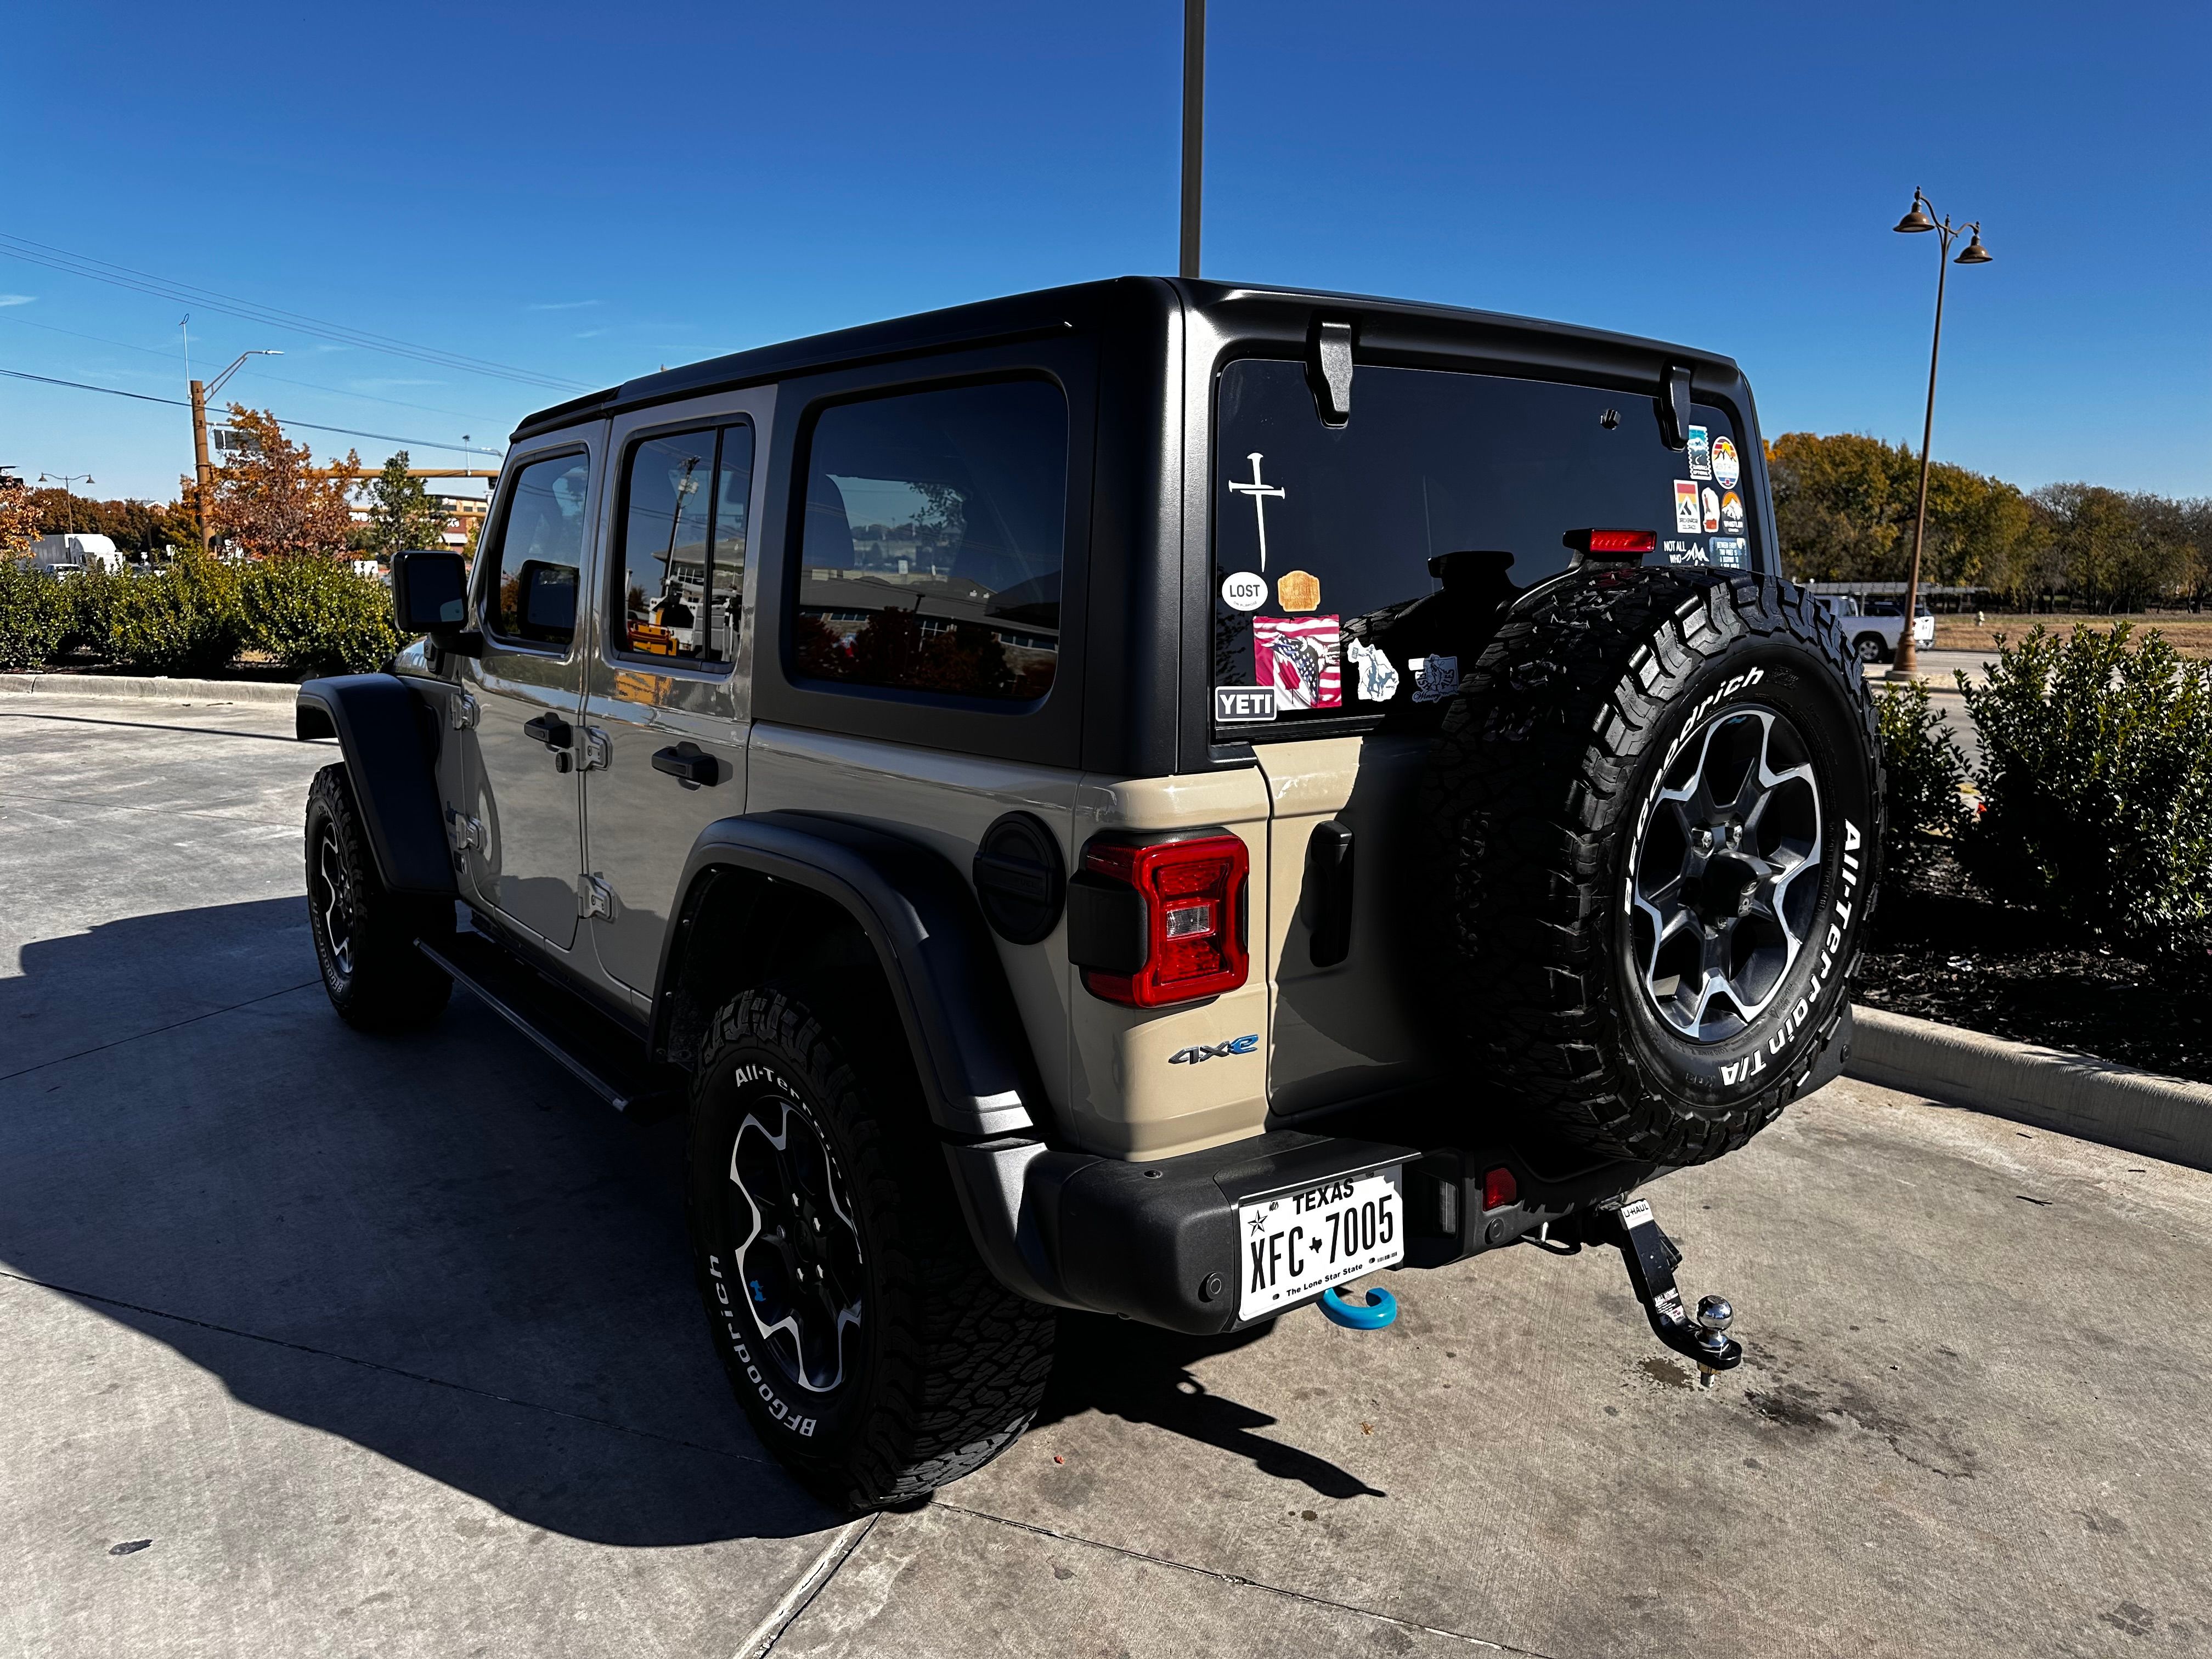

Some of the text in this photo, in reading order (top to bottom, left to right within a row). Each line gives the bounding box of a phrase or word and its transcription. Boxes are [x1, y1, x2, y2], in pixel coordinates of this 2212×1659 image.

[1663, 540, 1687, 552] NOT ALL
[1669, 554, 1682, 564] WHO
[1229, 584, 1260, 597] LOST
[1219, 694, 1271, 714] YETI
[1768, 818, 1861, 1055] All-Terrain
[1720, 1049, 1767, 1086] T/A
[1292, 1177, 1354, 1215] TEXAS
[1623, 1203, 1649, 1218] U-HAUL
[1250, 1194, 1394, 1294] XFC 7005
[1286, 1263, 1363, 1297] The Lone Star State
[708, 1254, 817, 1437] BFGoodrich
